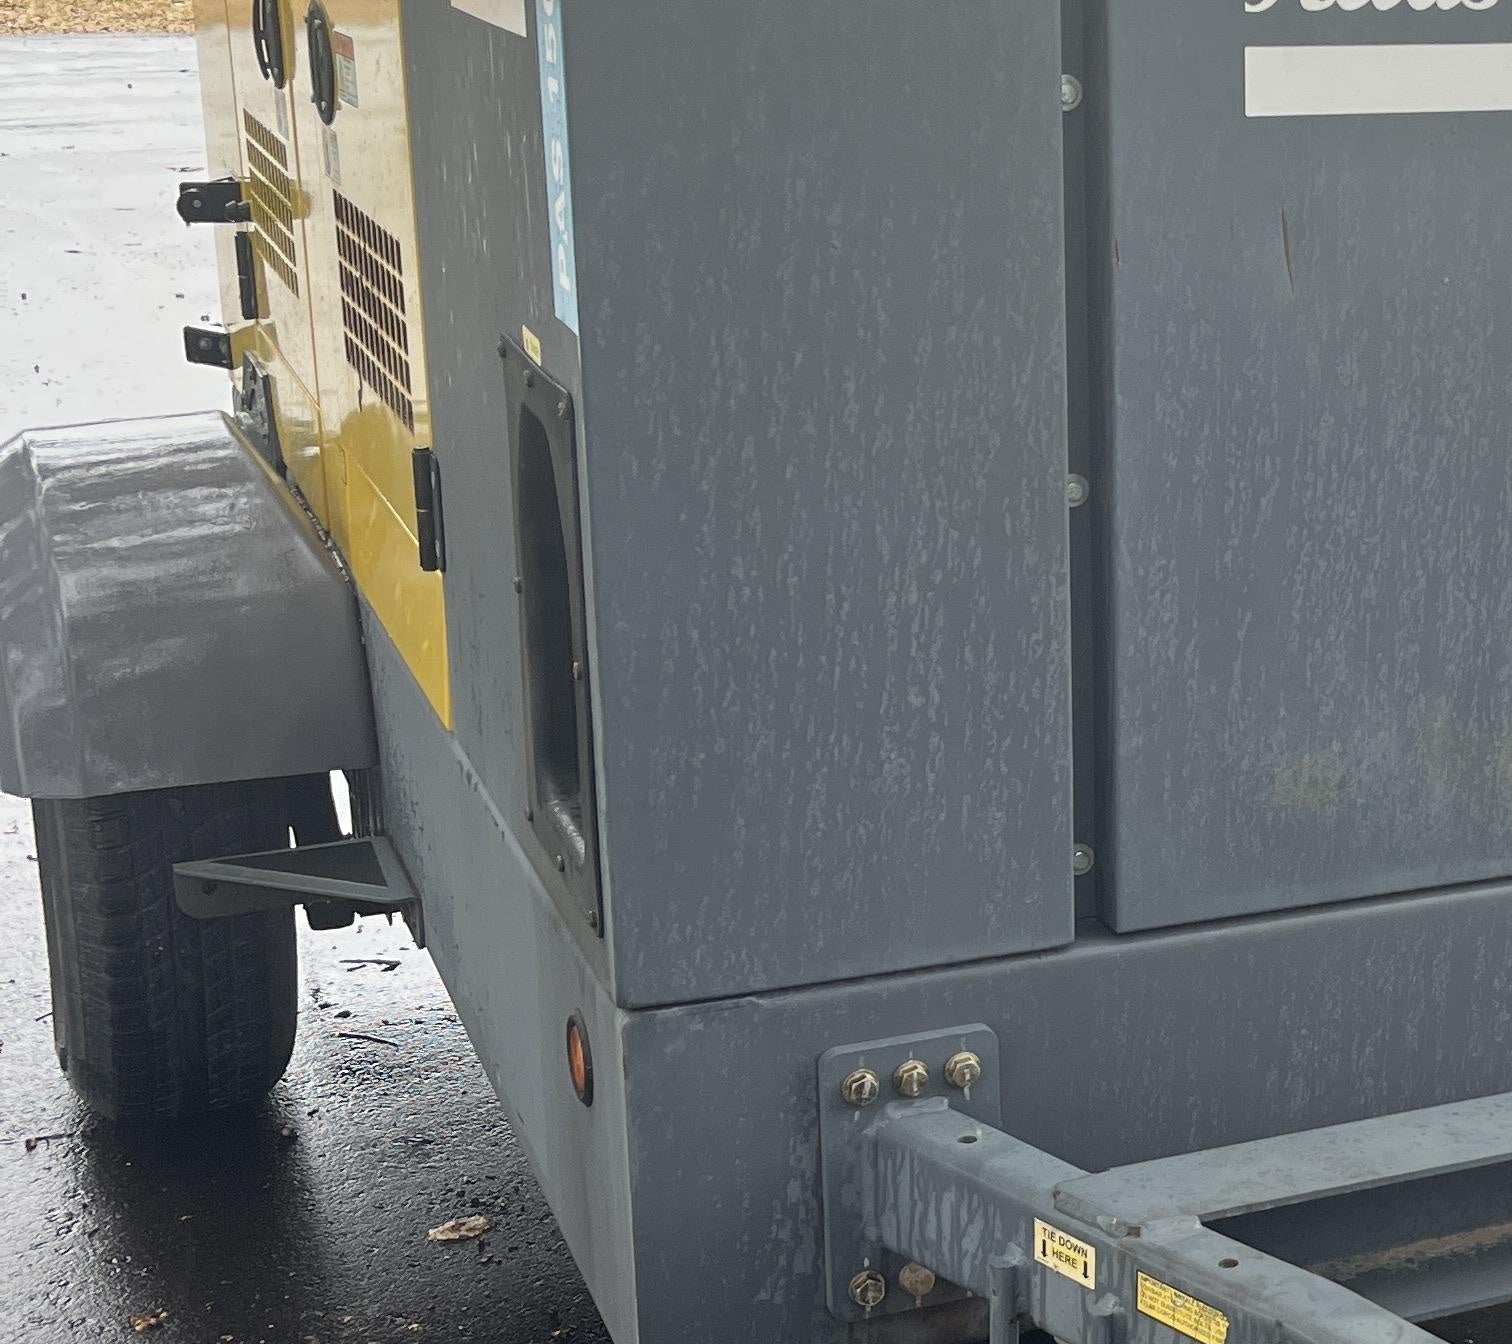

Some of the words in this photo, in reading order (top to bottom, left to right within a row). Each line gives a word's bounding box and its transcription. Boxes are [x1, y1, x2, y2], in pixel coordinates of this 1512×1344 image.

[552, 140, 571, 290] PAS
[1041, 1227, 1056, 1243] TIE
[1058, 1235, 1088, 1259] DOWN
[1051, 1248, 1078, 1270] HERE
